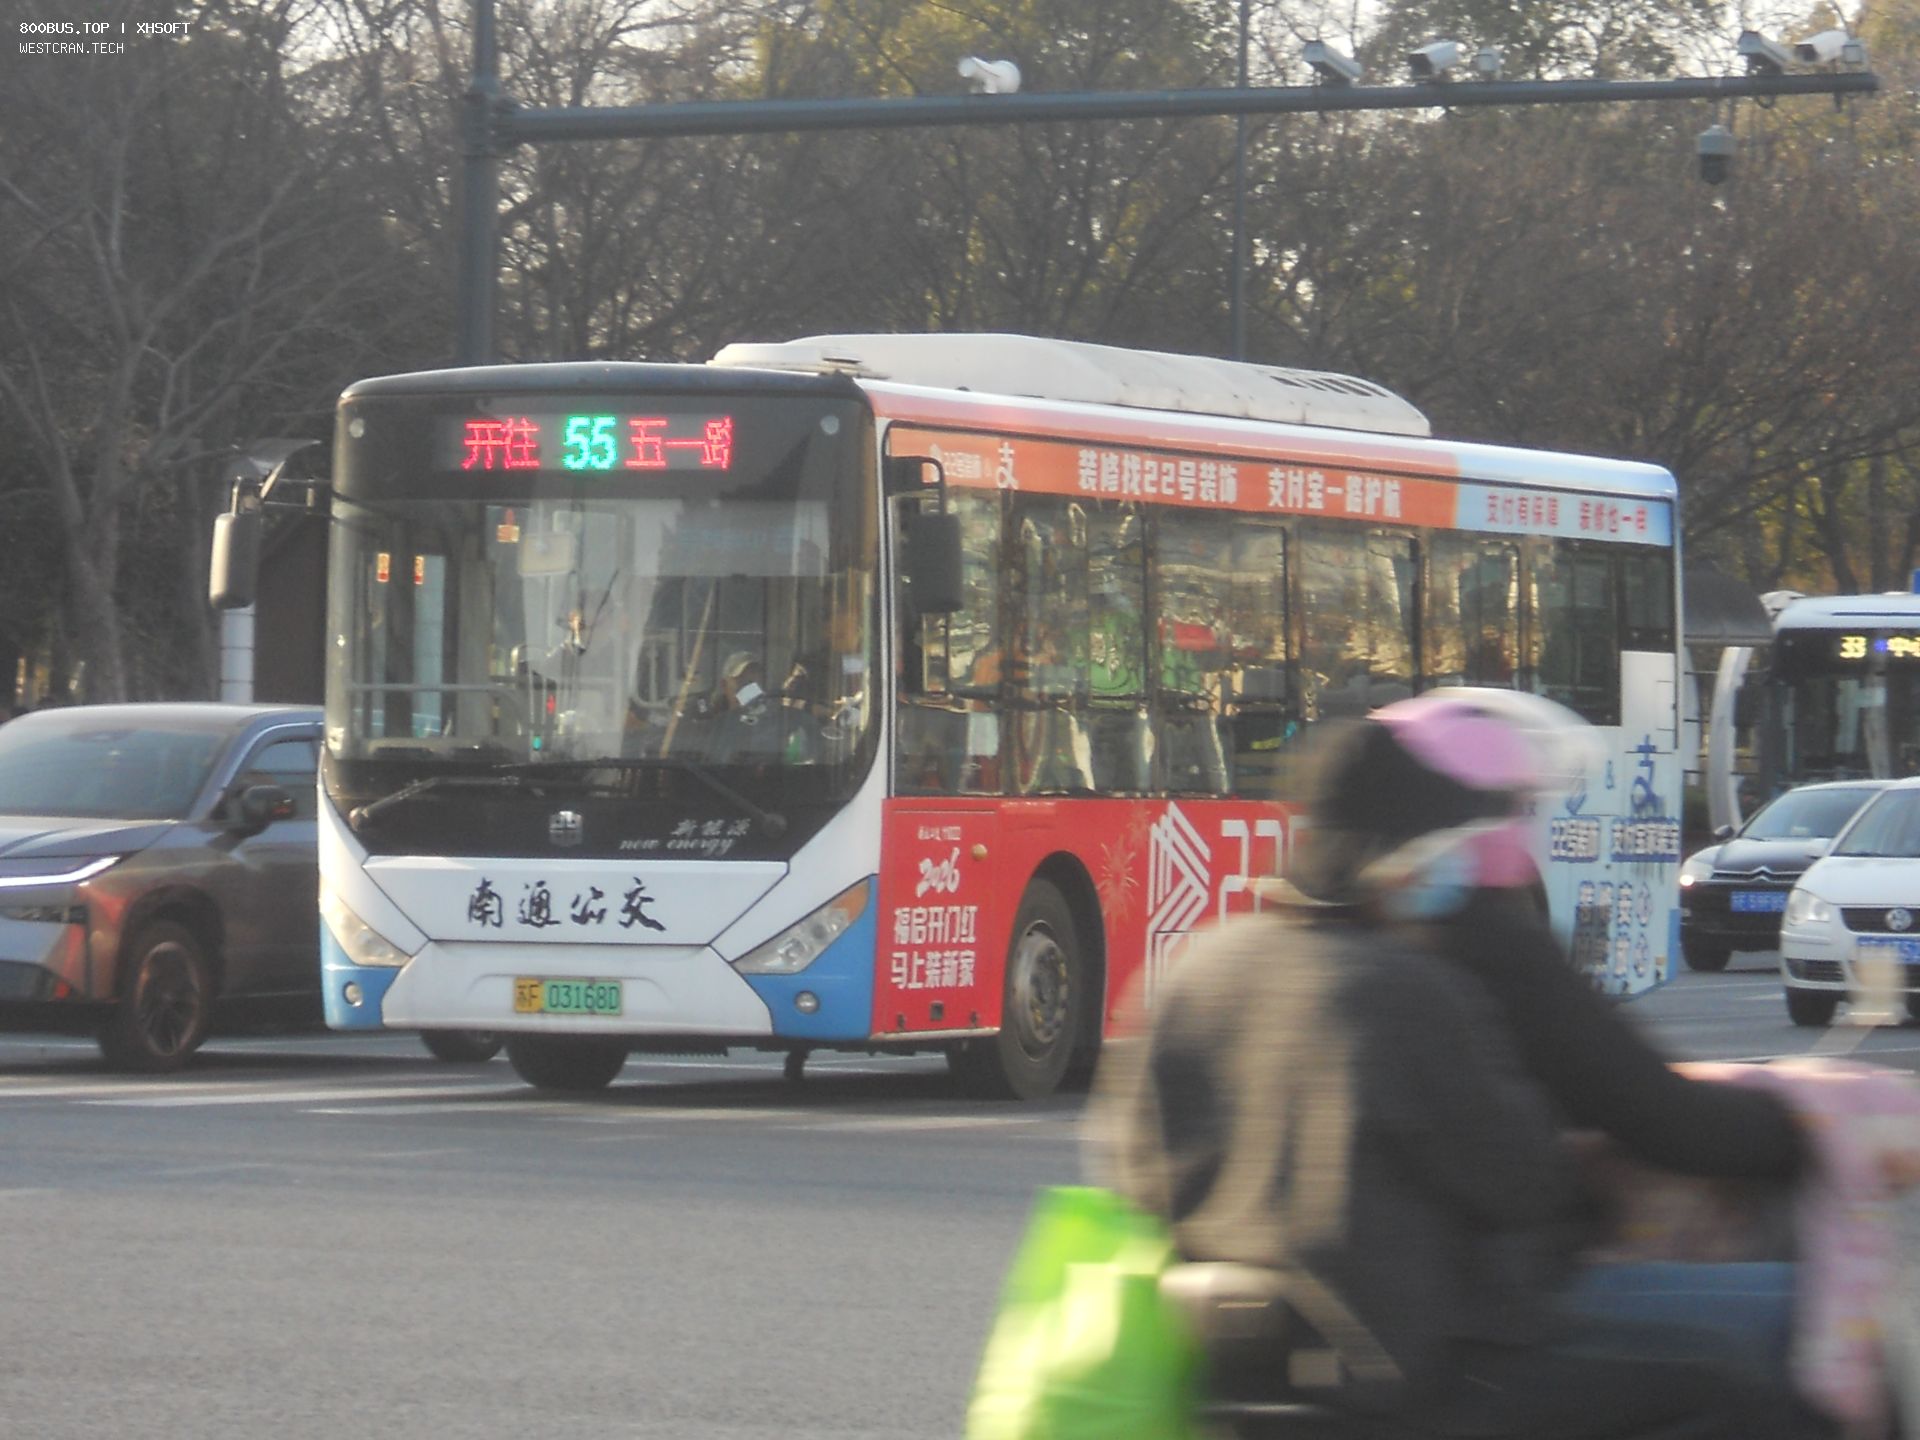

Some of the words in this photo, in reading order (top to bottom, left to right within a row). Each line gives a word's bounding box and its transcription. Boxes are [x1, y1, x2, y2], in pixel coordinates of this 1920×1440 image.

[461, 417, 540, 470] 开往
[563, 416, 617, 470] 55
[1840, 636, 1866, 658] 33
[619, 838, 660, 851] new
[667, 837, 734, 857] energy
[671, 818, 751, 837] 新能源
[916, 847, 961, 898] 2026
[468, 876, 667, 932] 南通公交
[891, 949, 976, 989] 马上装新家
